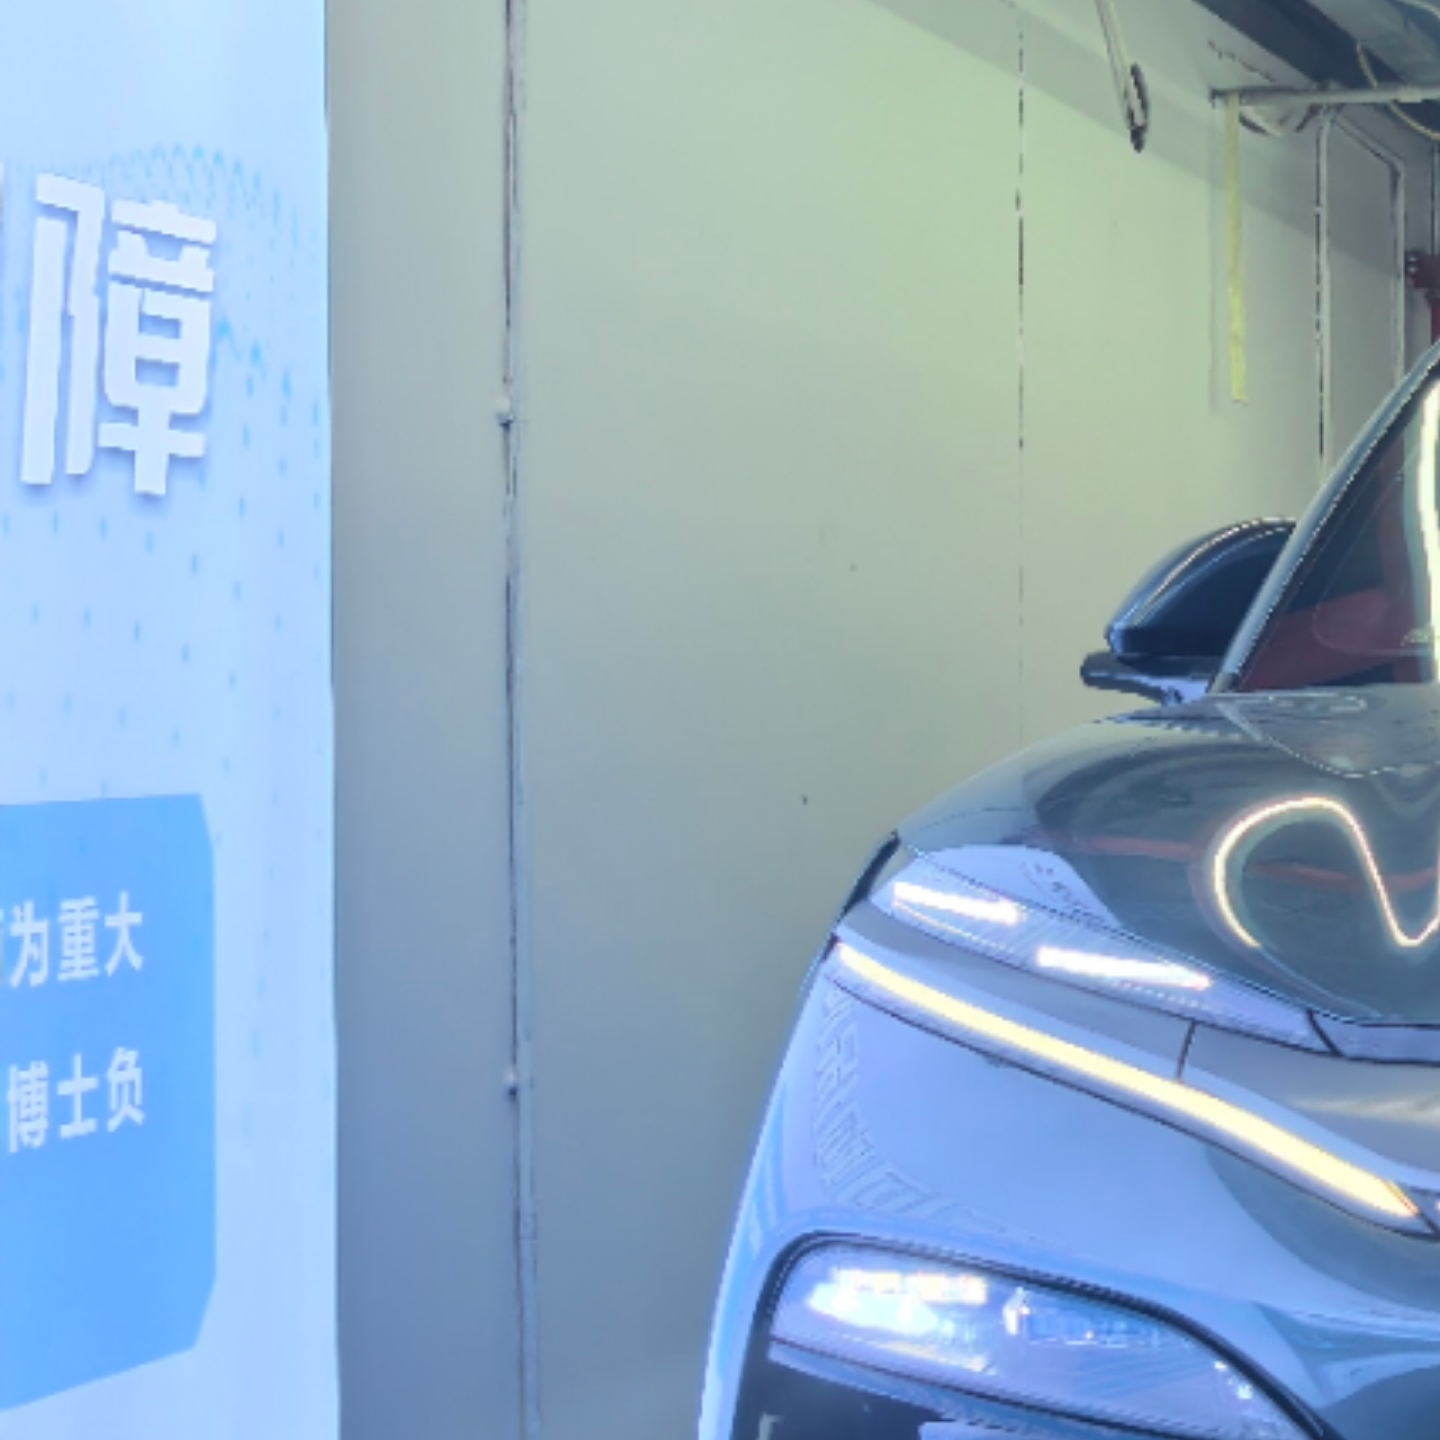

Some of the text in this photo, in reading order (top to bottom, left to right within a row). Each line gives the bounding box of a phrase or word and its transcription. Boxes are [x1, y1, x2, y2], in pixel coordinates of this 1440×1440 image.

[0, 890, 144, 989] 为重大
[6, 1046, 146, 1154] 博士负
